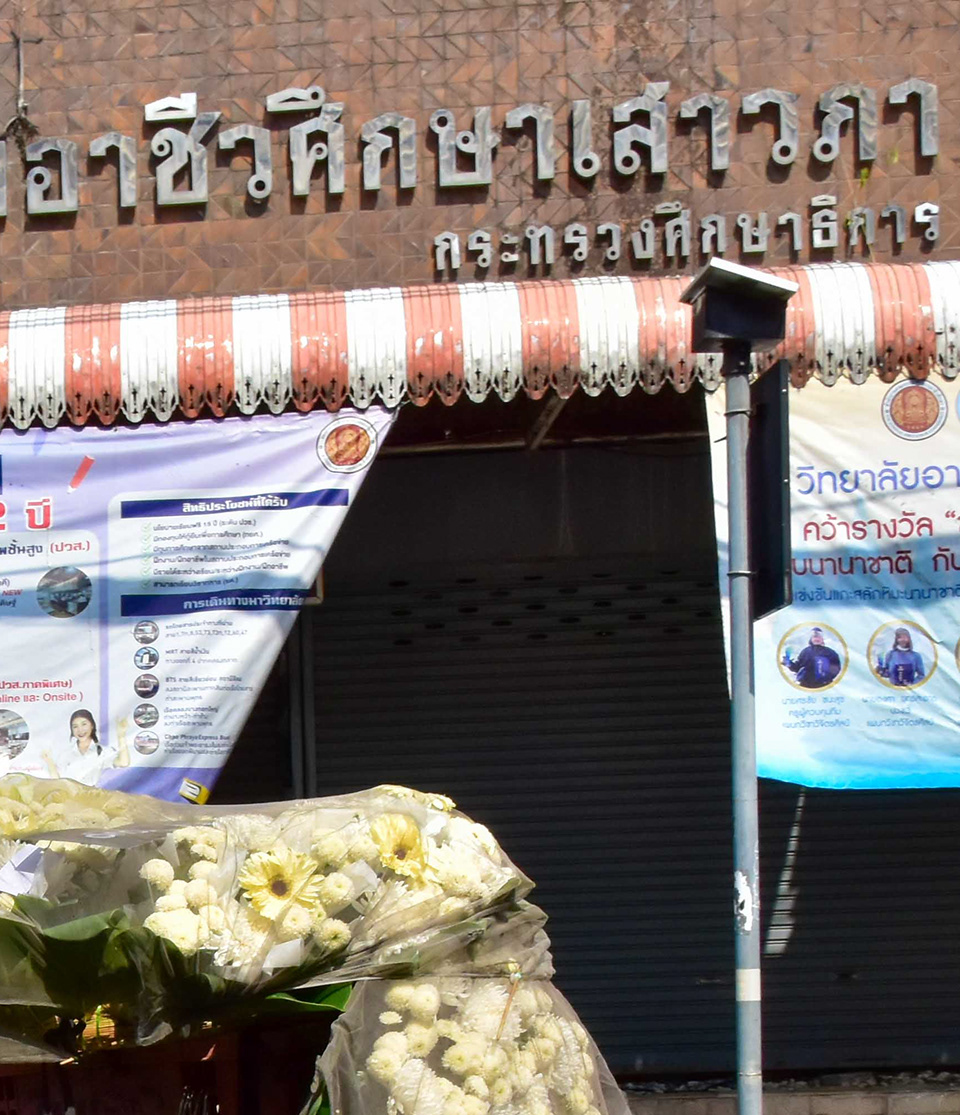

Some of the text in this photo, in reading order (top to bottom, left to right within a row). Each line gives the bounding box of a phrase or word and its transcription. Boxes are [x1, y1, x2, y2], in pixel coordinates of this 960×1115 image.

[434, 194, 940, 271] กระทรวงศึกษาธิการ
[25, 498, 52, 530] ปี
[803, 510, 933, 541] คว้ารางวัล
[49, 540, 91, 553] (ปวส.)
[2, 589, 23, 597] NEW
[43, 692, 77, 702] Onsite
